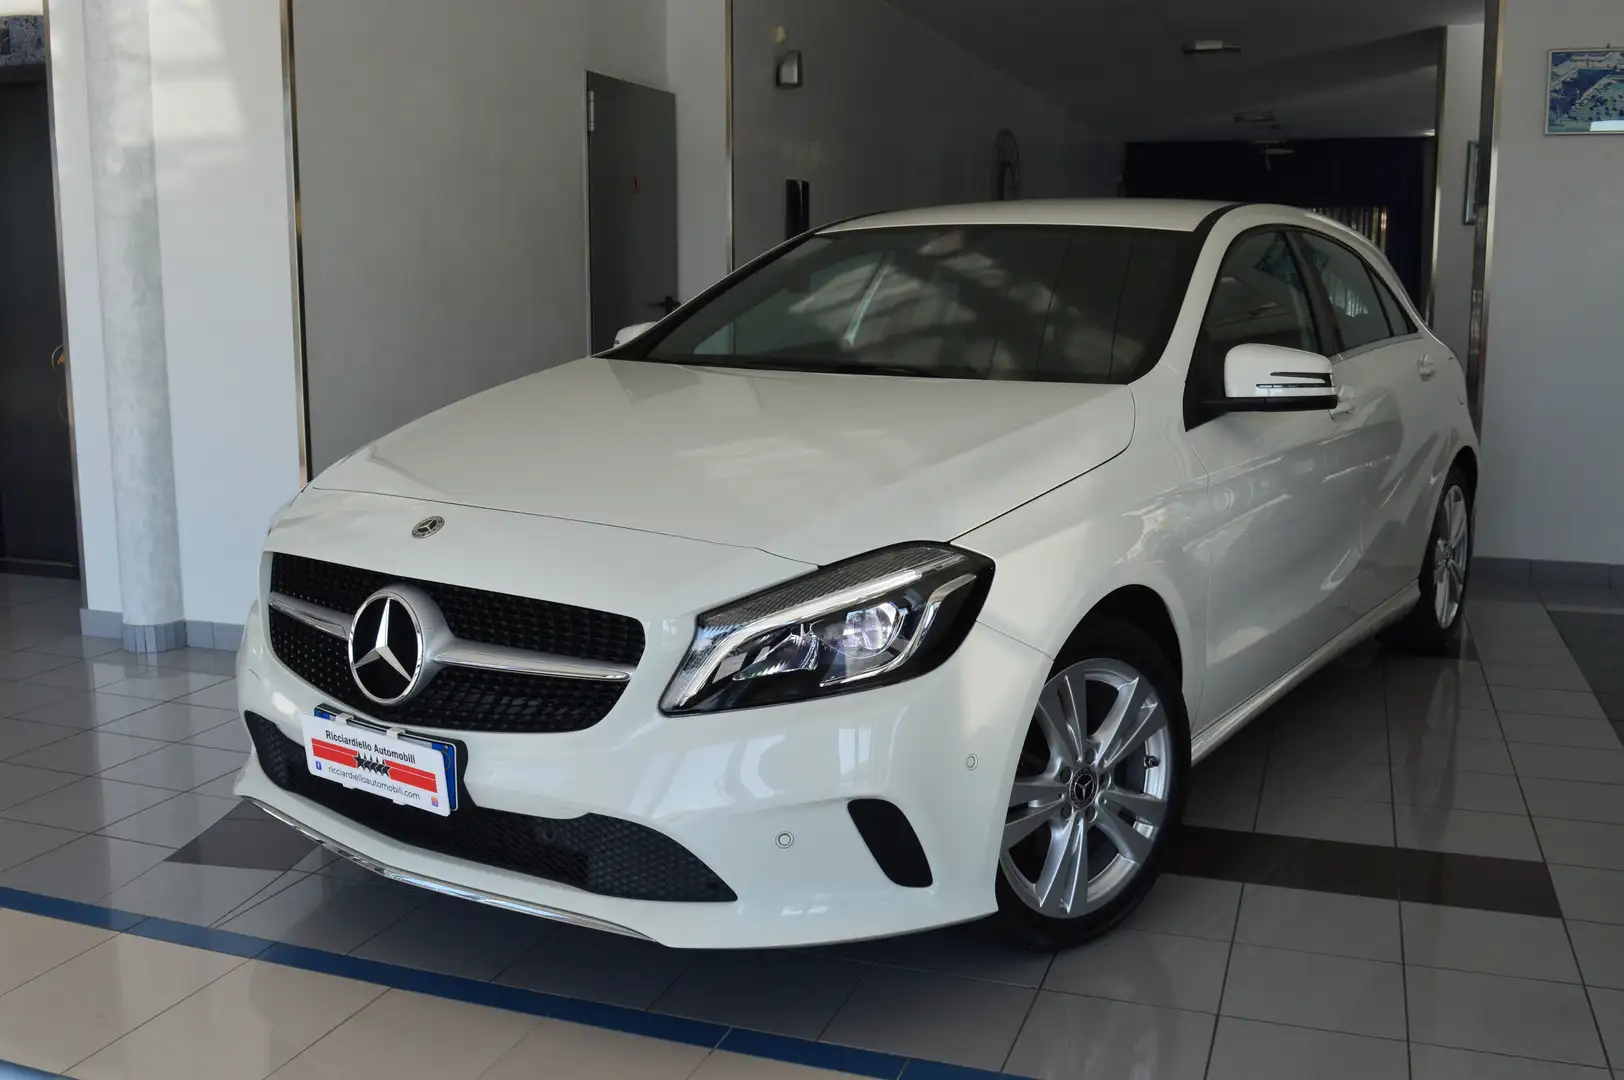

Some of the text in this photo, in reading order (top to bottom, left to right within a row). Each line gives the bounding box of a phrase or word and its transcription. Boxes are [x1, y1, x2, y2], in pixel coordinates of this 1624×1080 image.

[325, 730, 416, 764] Ricciardiello Automobili
[328, 766, 421, 800] ricciardielloautomobili.com
